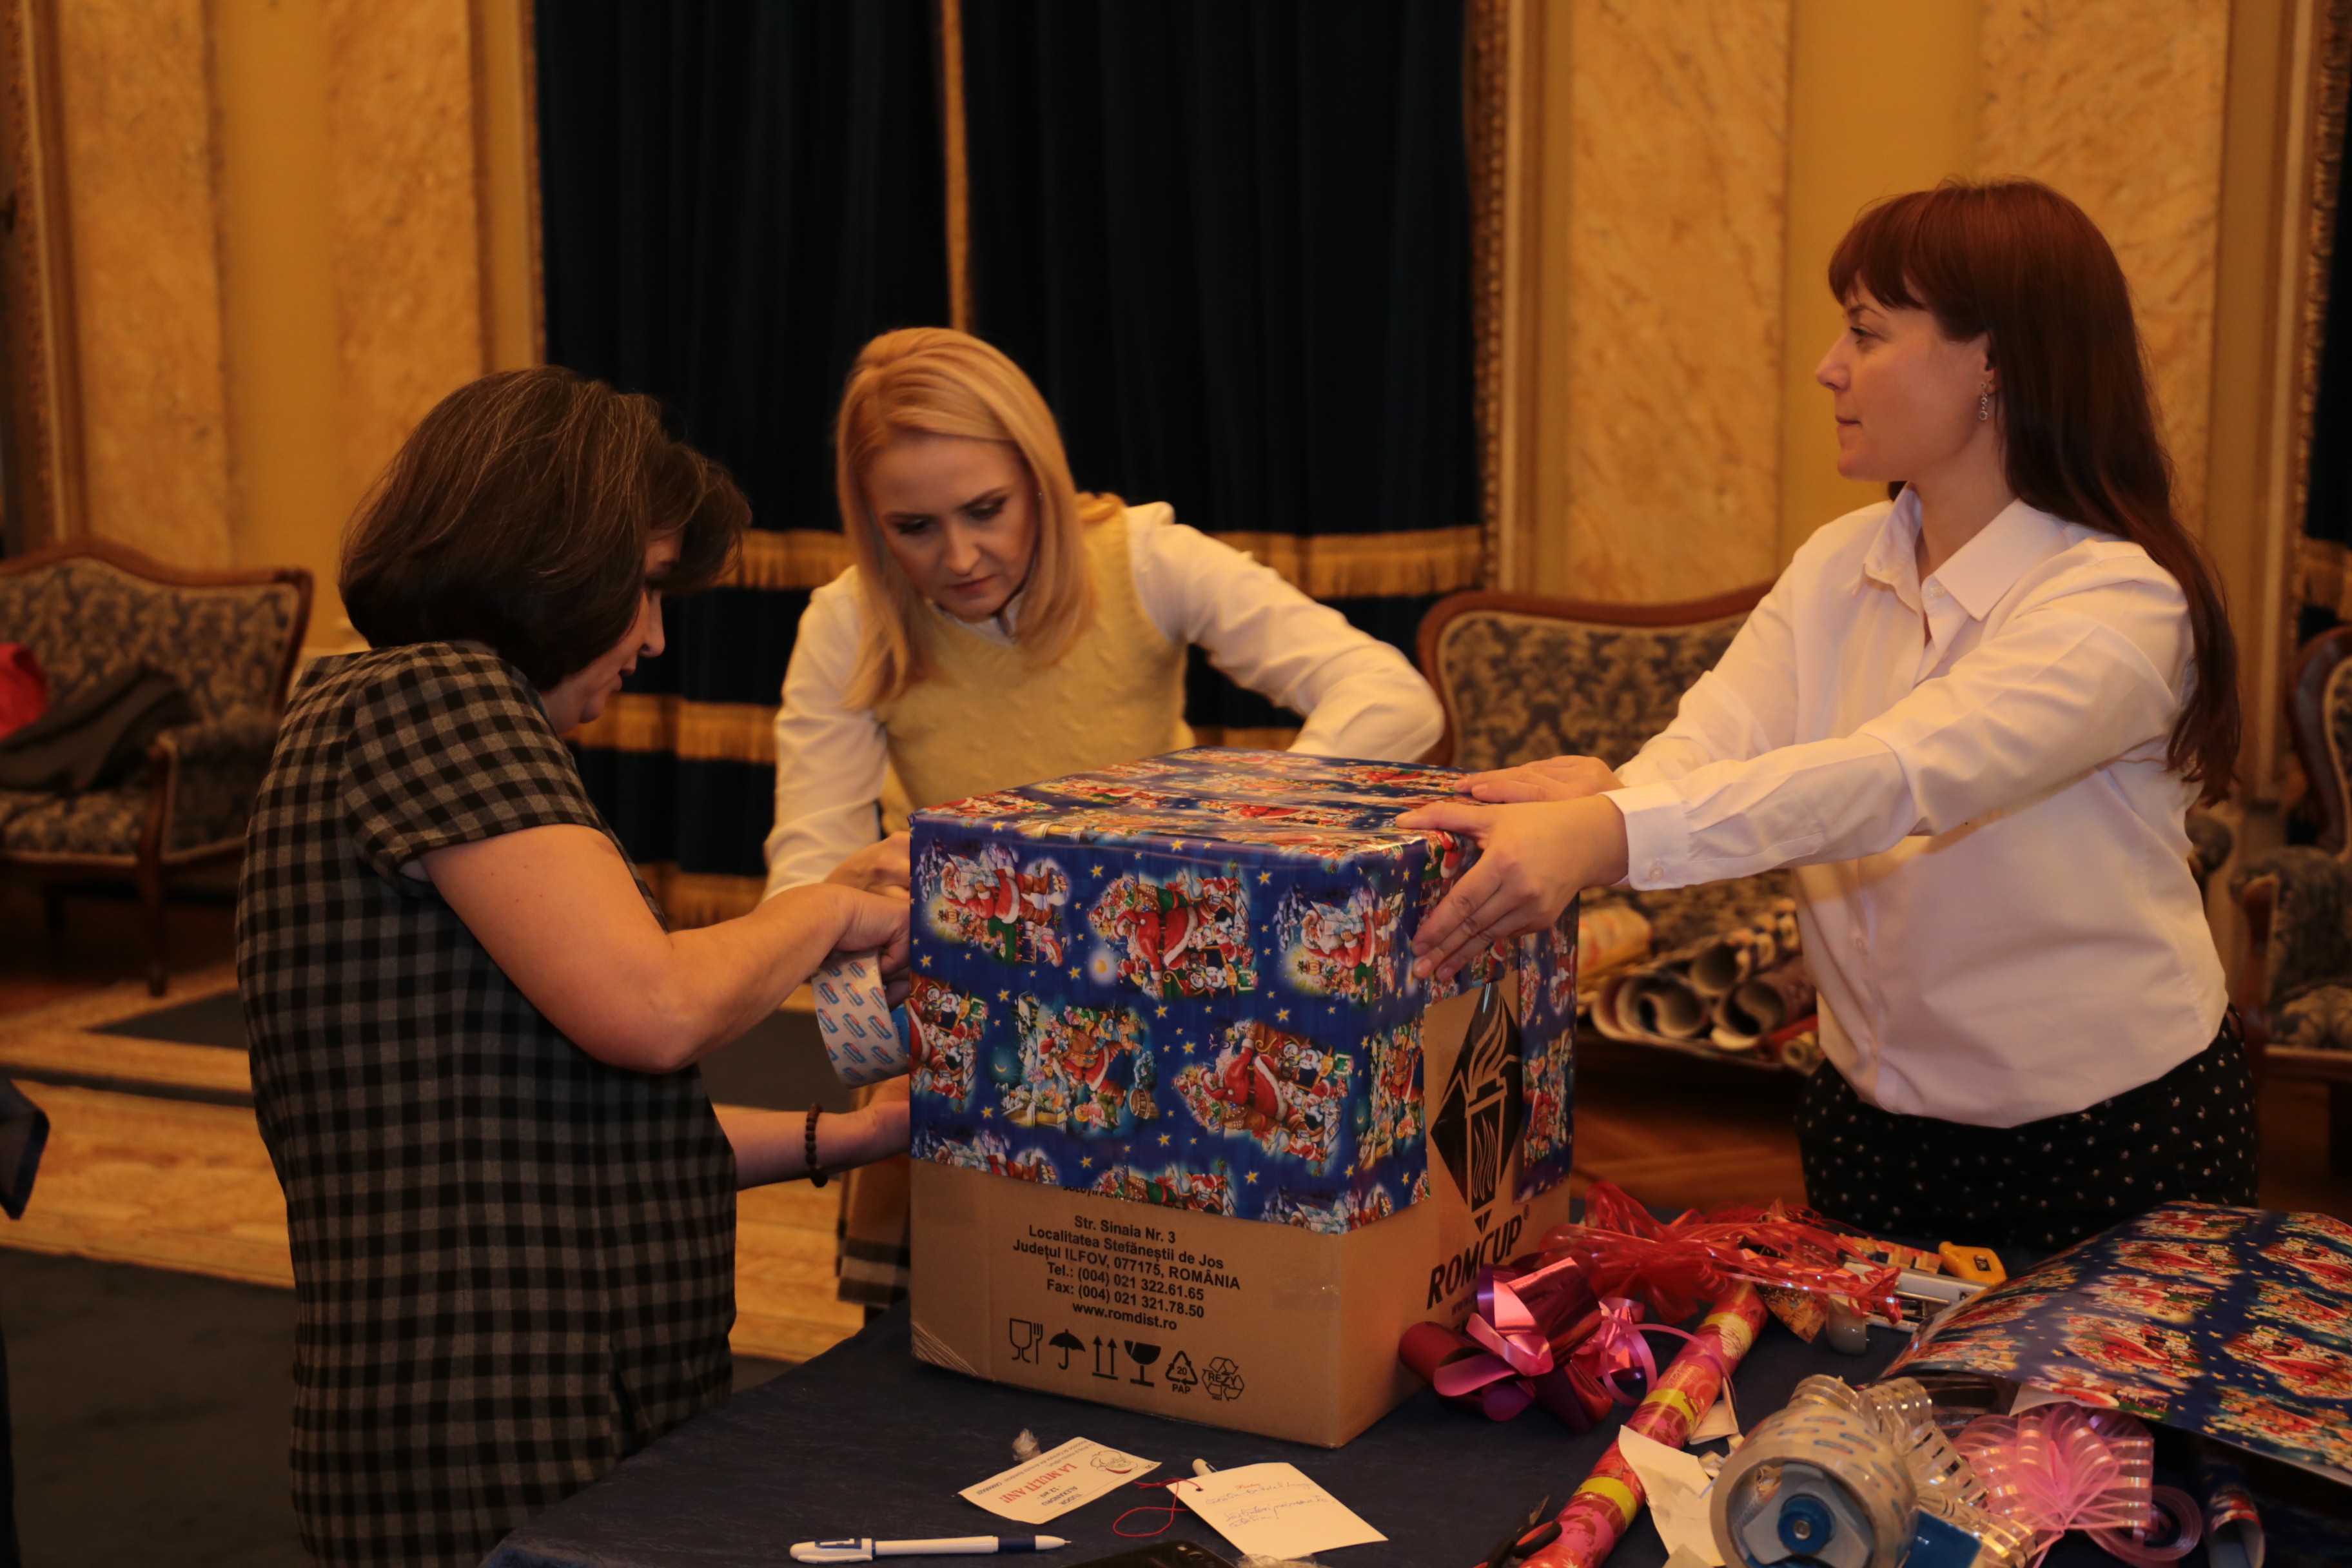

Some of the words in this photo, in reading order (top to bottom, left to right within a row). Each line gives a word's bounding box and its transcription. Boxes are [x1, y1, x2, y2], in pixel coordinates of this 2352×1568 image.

[1074, 1215, 1096, 1231] Str.
[1100, 1219, 1141, 1238] Sinaia
[1145, 1227, 1164, 1242] Nr.
[1168, 1231, 1176, 1244] 3
[1029, 1224, 1100, 1248] Localitatea
[1178, 1251, 1195, 1264] de
[1199, 1254, 1224, 1269] Jos
[1065, 1248, 1110, 1269] ILFOV,
[1113, 1256, 1164, 1279] 077175,
[1168, 1266, 1240, 1289] ROMÂNIA
[1427, 1215, 1522, 1310] ROMCUP
[1047, 1262, 1073, 1278] Tel.:
[1077, 1267, 1110, 1287] (004)
[1113, 1274, 1136, 1288] 021
[1141, 1279, 1204, 1301] 322.61.65
[1046, 1279, 1074, 1295] Fax:
[1078, 1284, 1110, 1304] (004)
[1114, 1291, 1137, 1306] 021
[1141, 1296, 1204, 1318] 321.78.50
[1072, 1302, 1177, 1331] www.romdist.ro
[1177, 1366, 1188, 1376] 20
[1172, 1384, 1191, 1394] PAP
[1058, 1462, 1078, 1473] LA
[999, 1488, 1027, 1504] ANI!
[1041, 1485, 1078, 1506] ALEXANDRU
[1059, 1493, 1084, 1505] TUDOR
